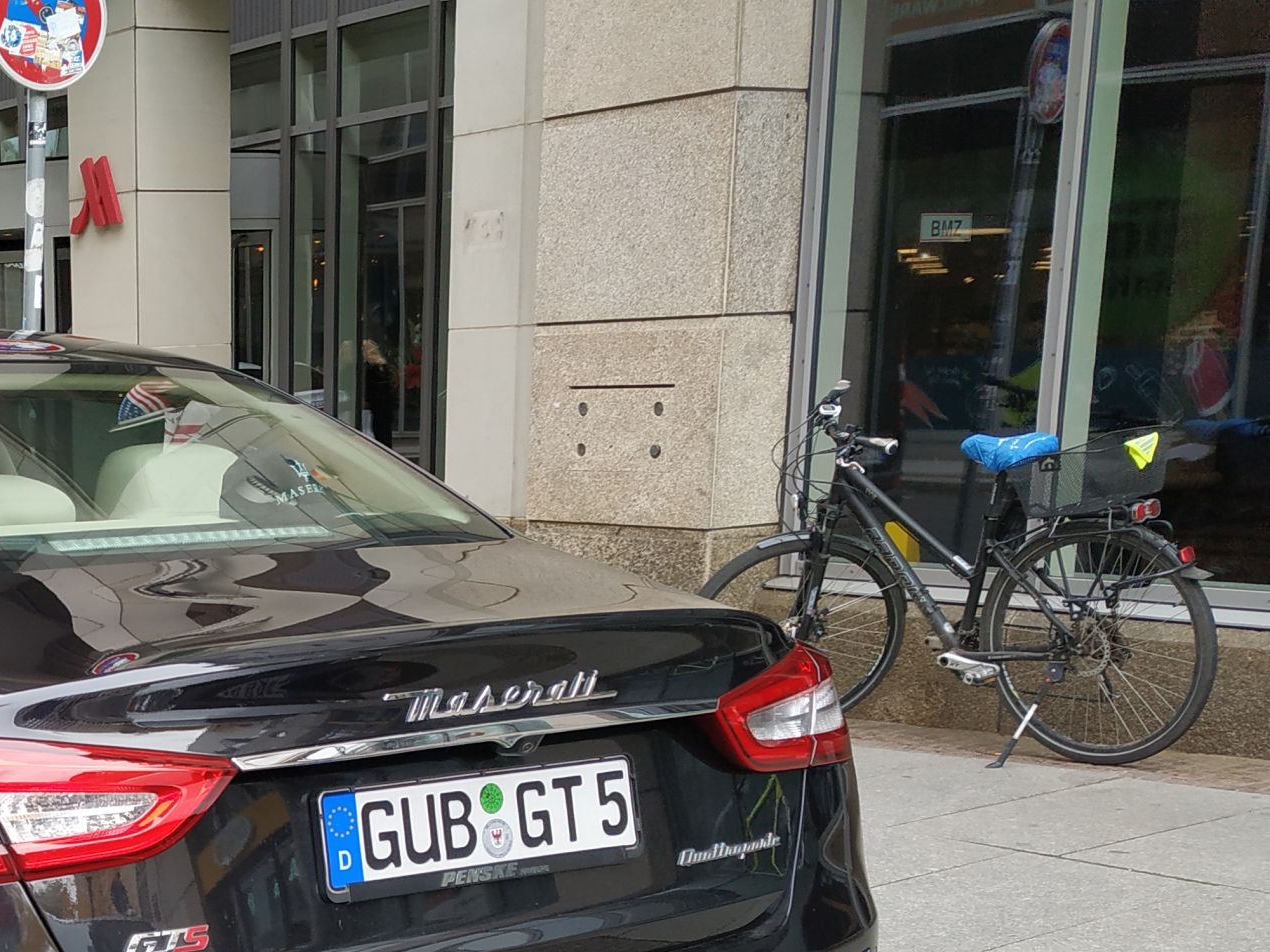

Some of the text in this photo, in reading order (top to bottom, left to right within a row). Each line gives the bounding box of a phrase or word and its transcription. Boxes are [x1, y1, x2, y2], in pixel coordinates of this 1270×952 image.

[931, 220, 963, 237] BMZ
[383, 669, 618, 723] Maserati
[338, 850, 352, 871] D
[360, 790, 478, 871] GUB
[515, 774, 583, 848] GT
[596, 769, 629, 837] 5
[440, 862, 519, 887] PENSKE
